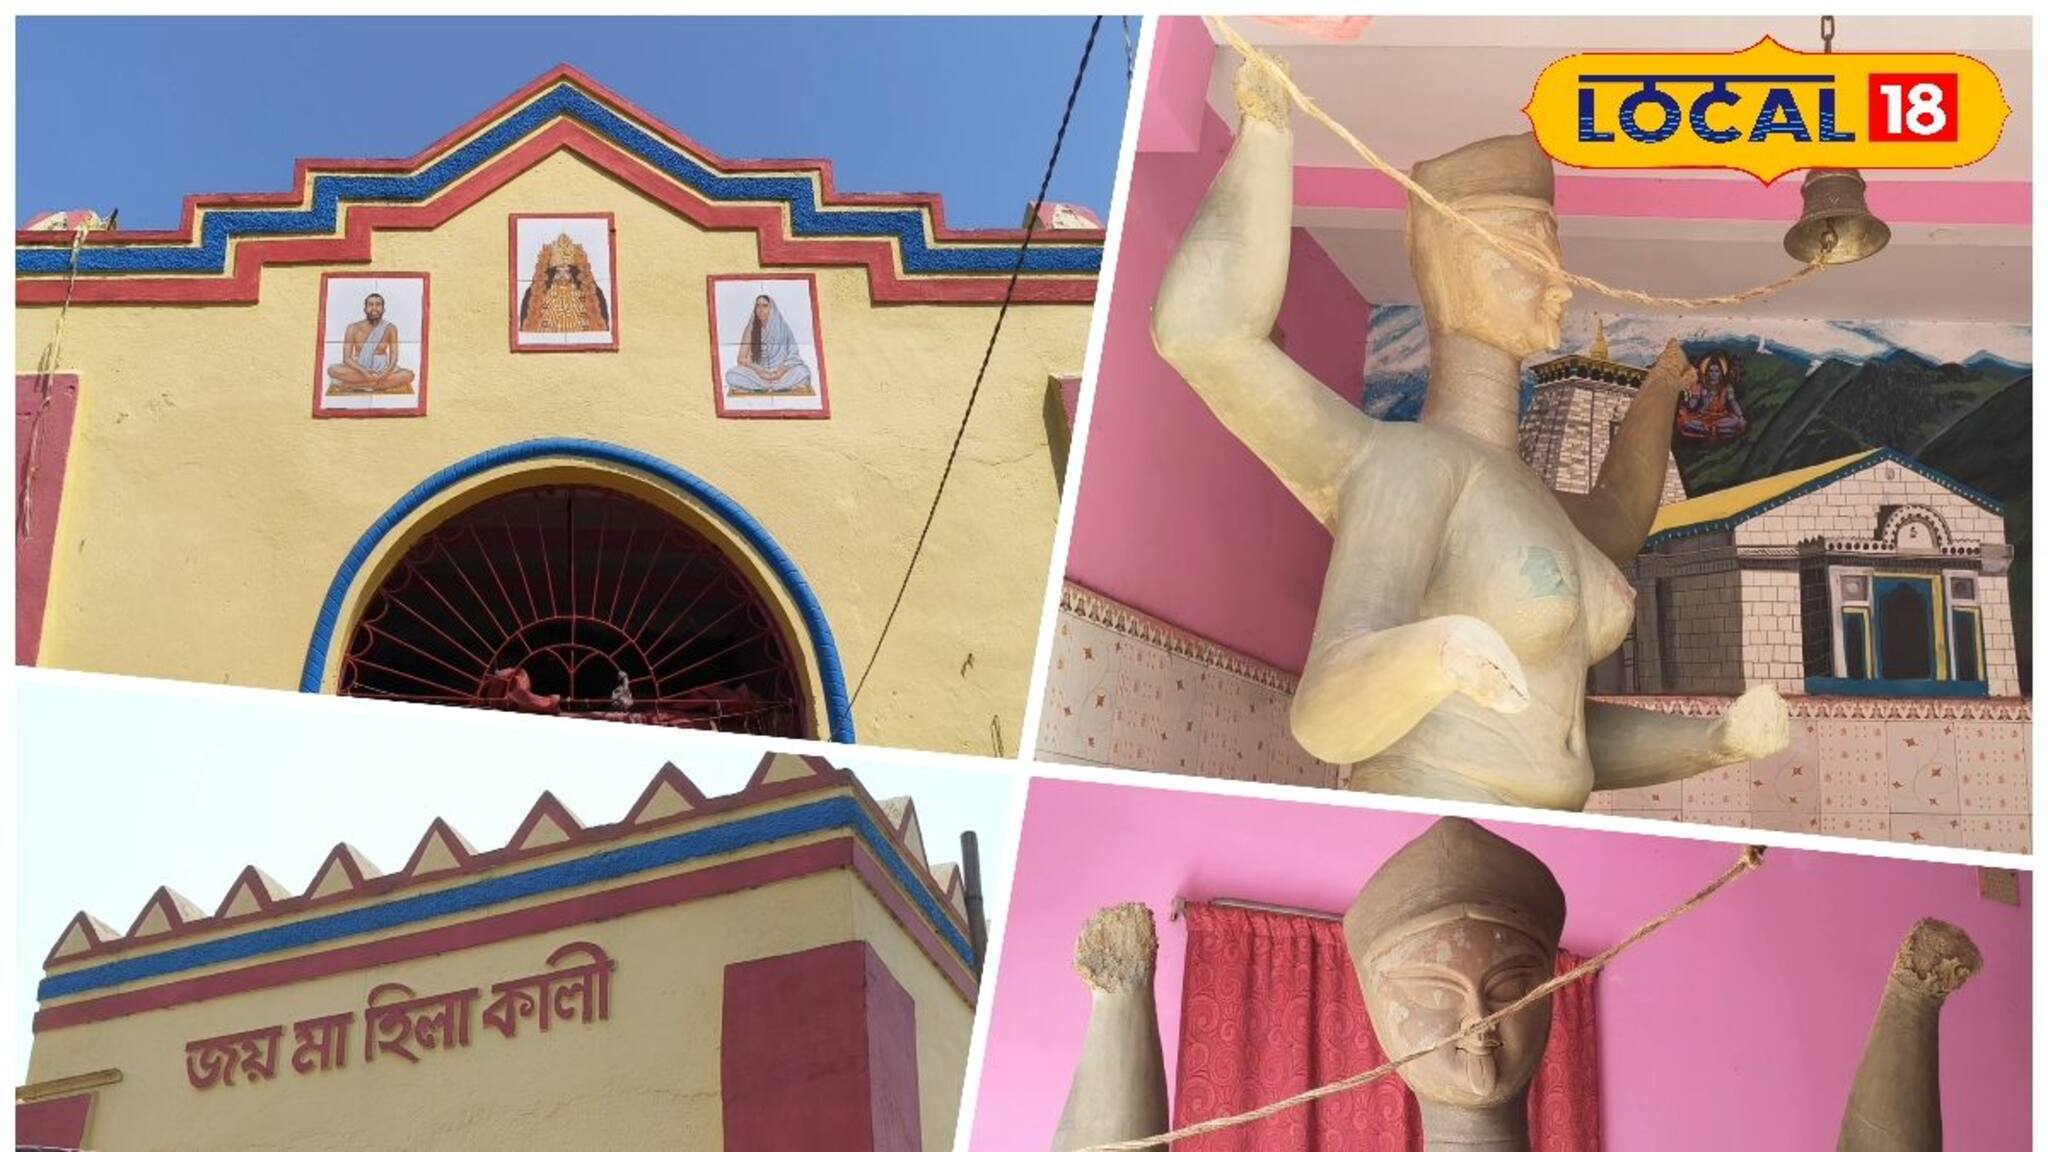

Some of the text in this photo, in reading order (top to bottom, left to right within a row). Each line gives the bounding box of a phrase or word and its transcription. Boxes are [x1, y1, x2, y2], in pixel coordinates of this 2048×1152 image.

[184, 940, 617, 1090] জয় মা হিলা কালী
